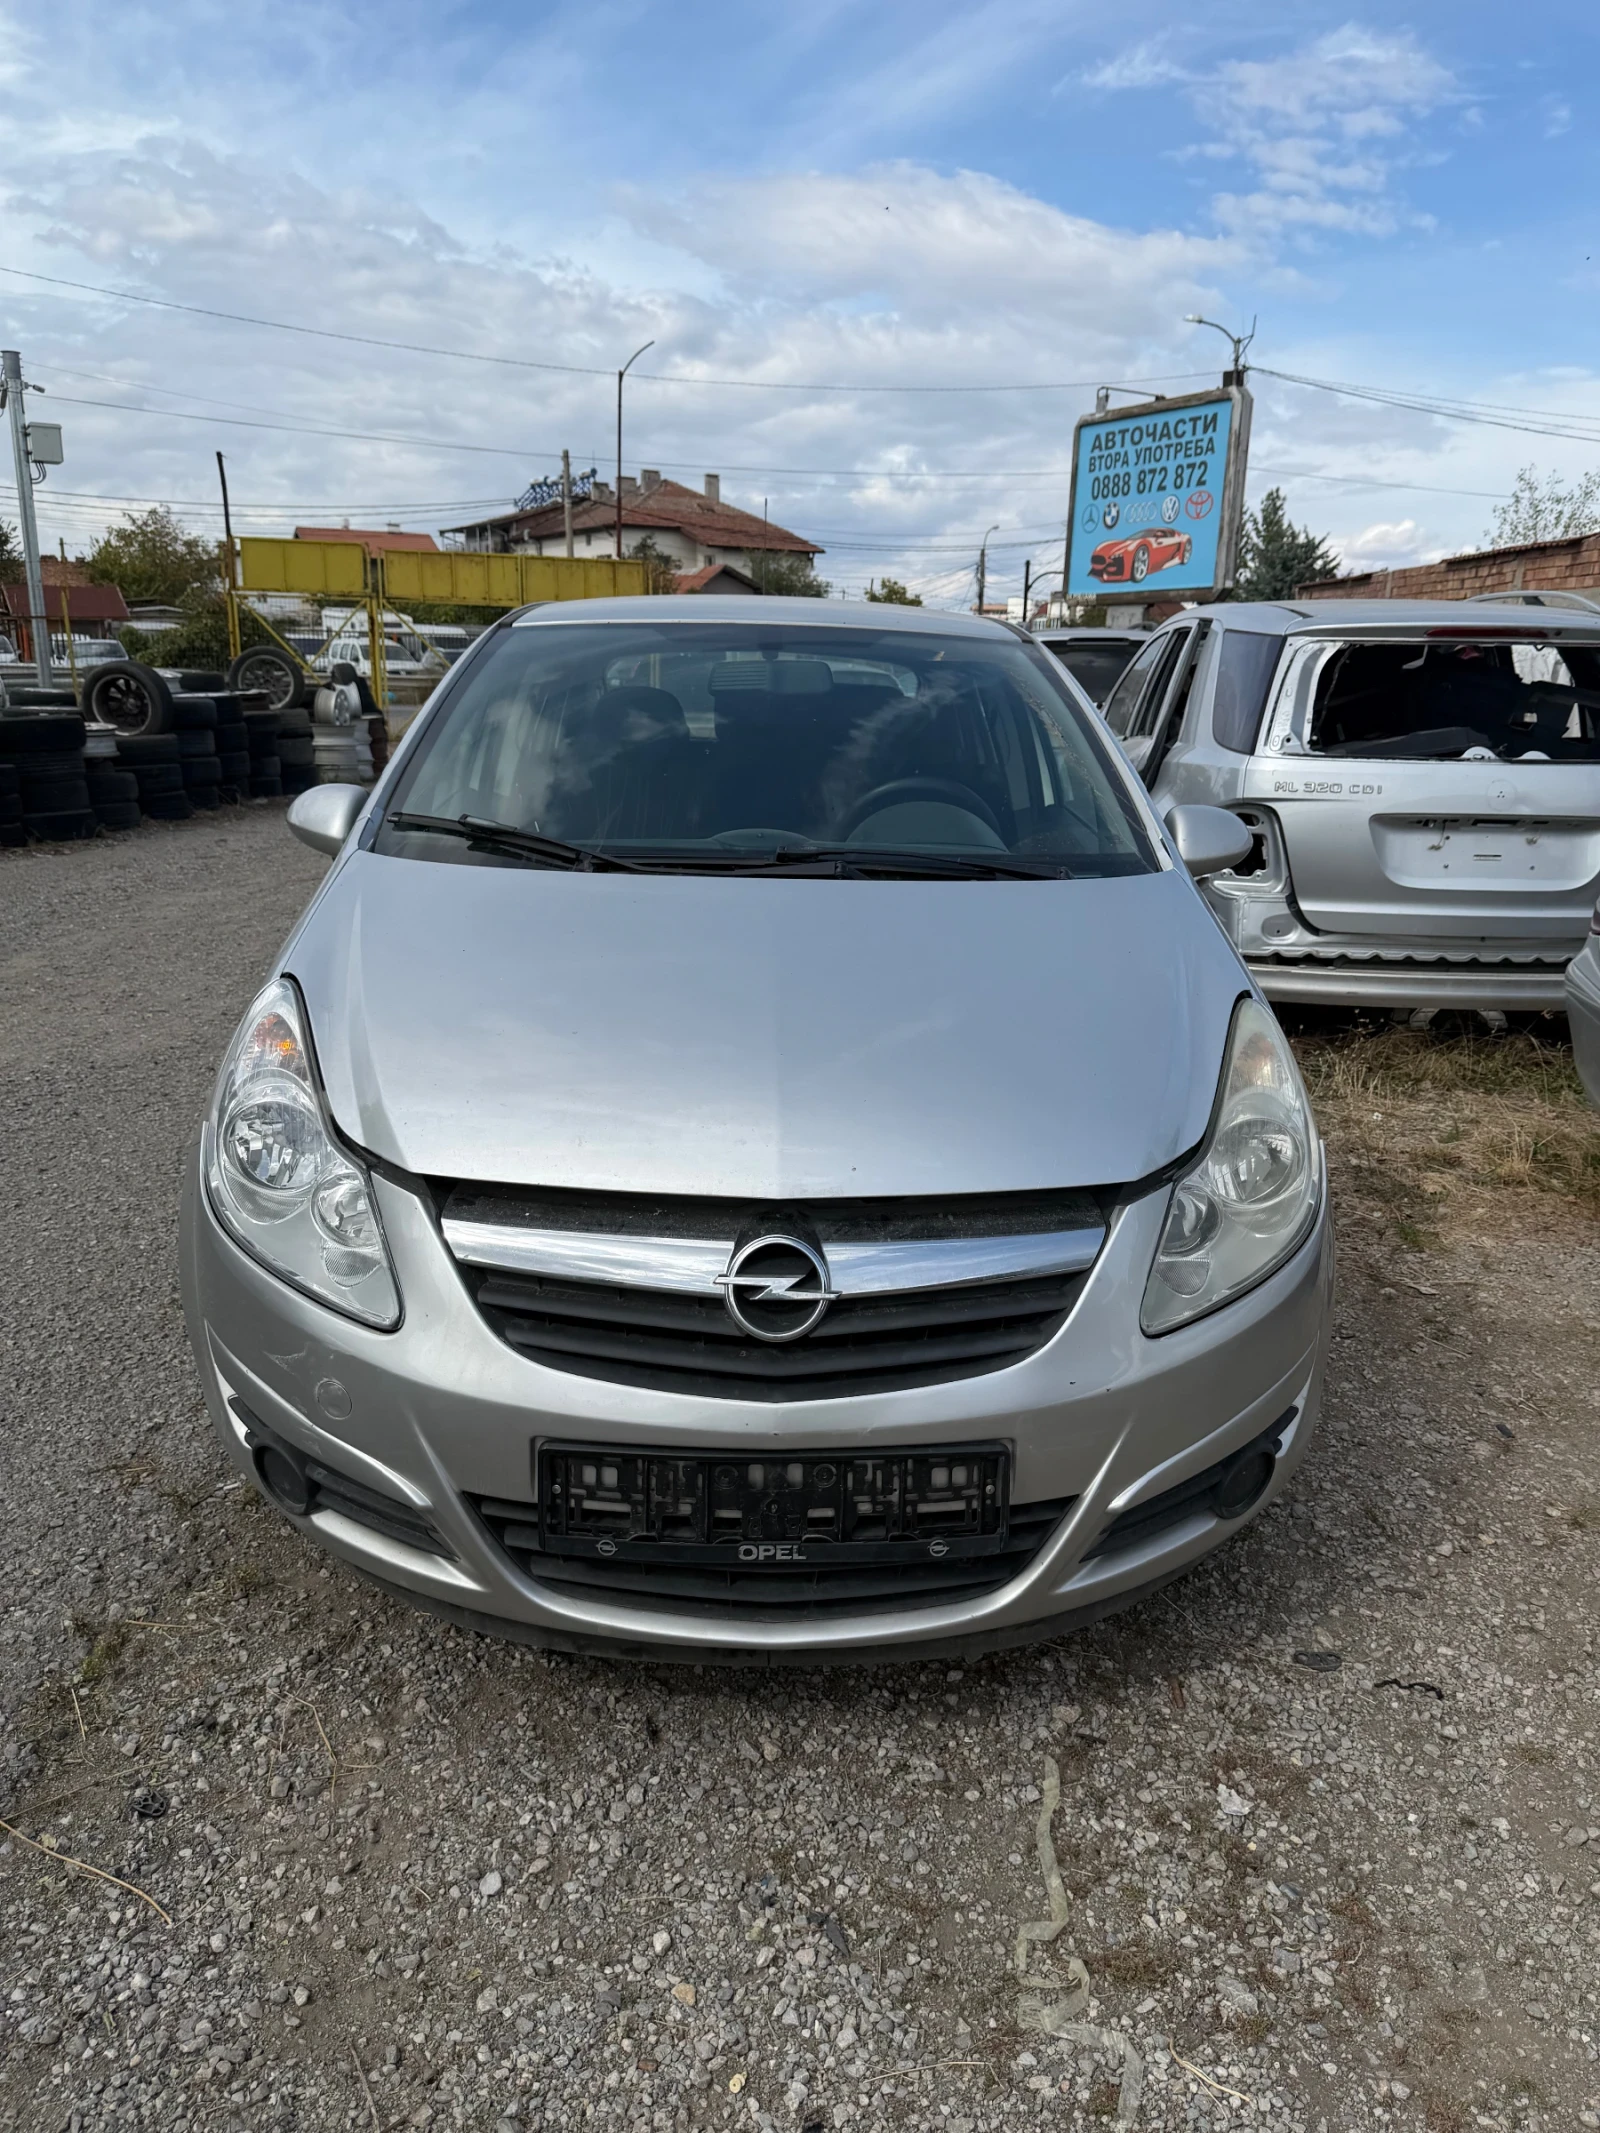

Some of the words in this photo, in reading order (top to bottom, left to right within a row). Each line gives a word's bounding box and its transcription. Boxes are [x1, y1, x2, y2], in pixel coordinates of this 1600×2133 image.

[1090, 412, 1218, 453] АВТОЧАСТИ
[1088, 450, 1129, 474] ВТОРА
[1134, 436, 1215, 466] УПОТРЕБА
[1091, 471, 1131, 500] 0888
[1136, 466, 1168, 494] 872
[1173, 460, 1208, 490] 872
[1274, 781, 1298, 792] ML
[1303, 782, 1342, 793] 320
[1349, 784, 1382, 794] CDI
[738, 1544, 807, 1560] OPEL
